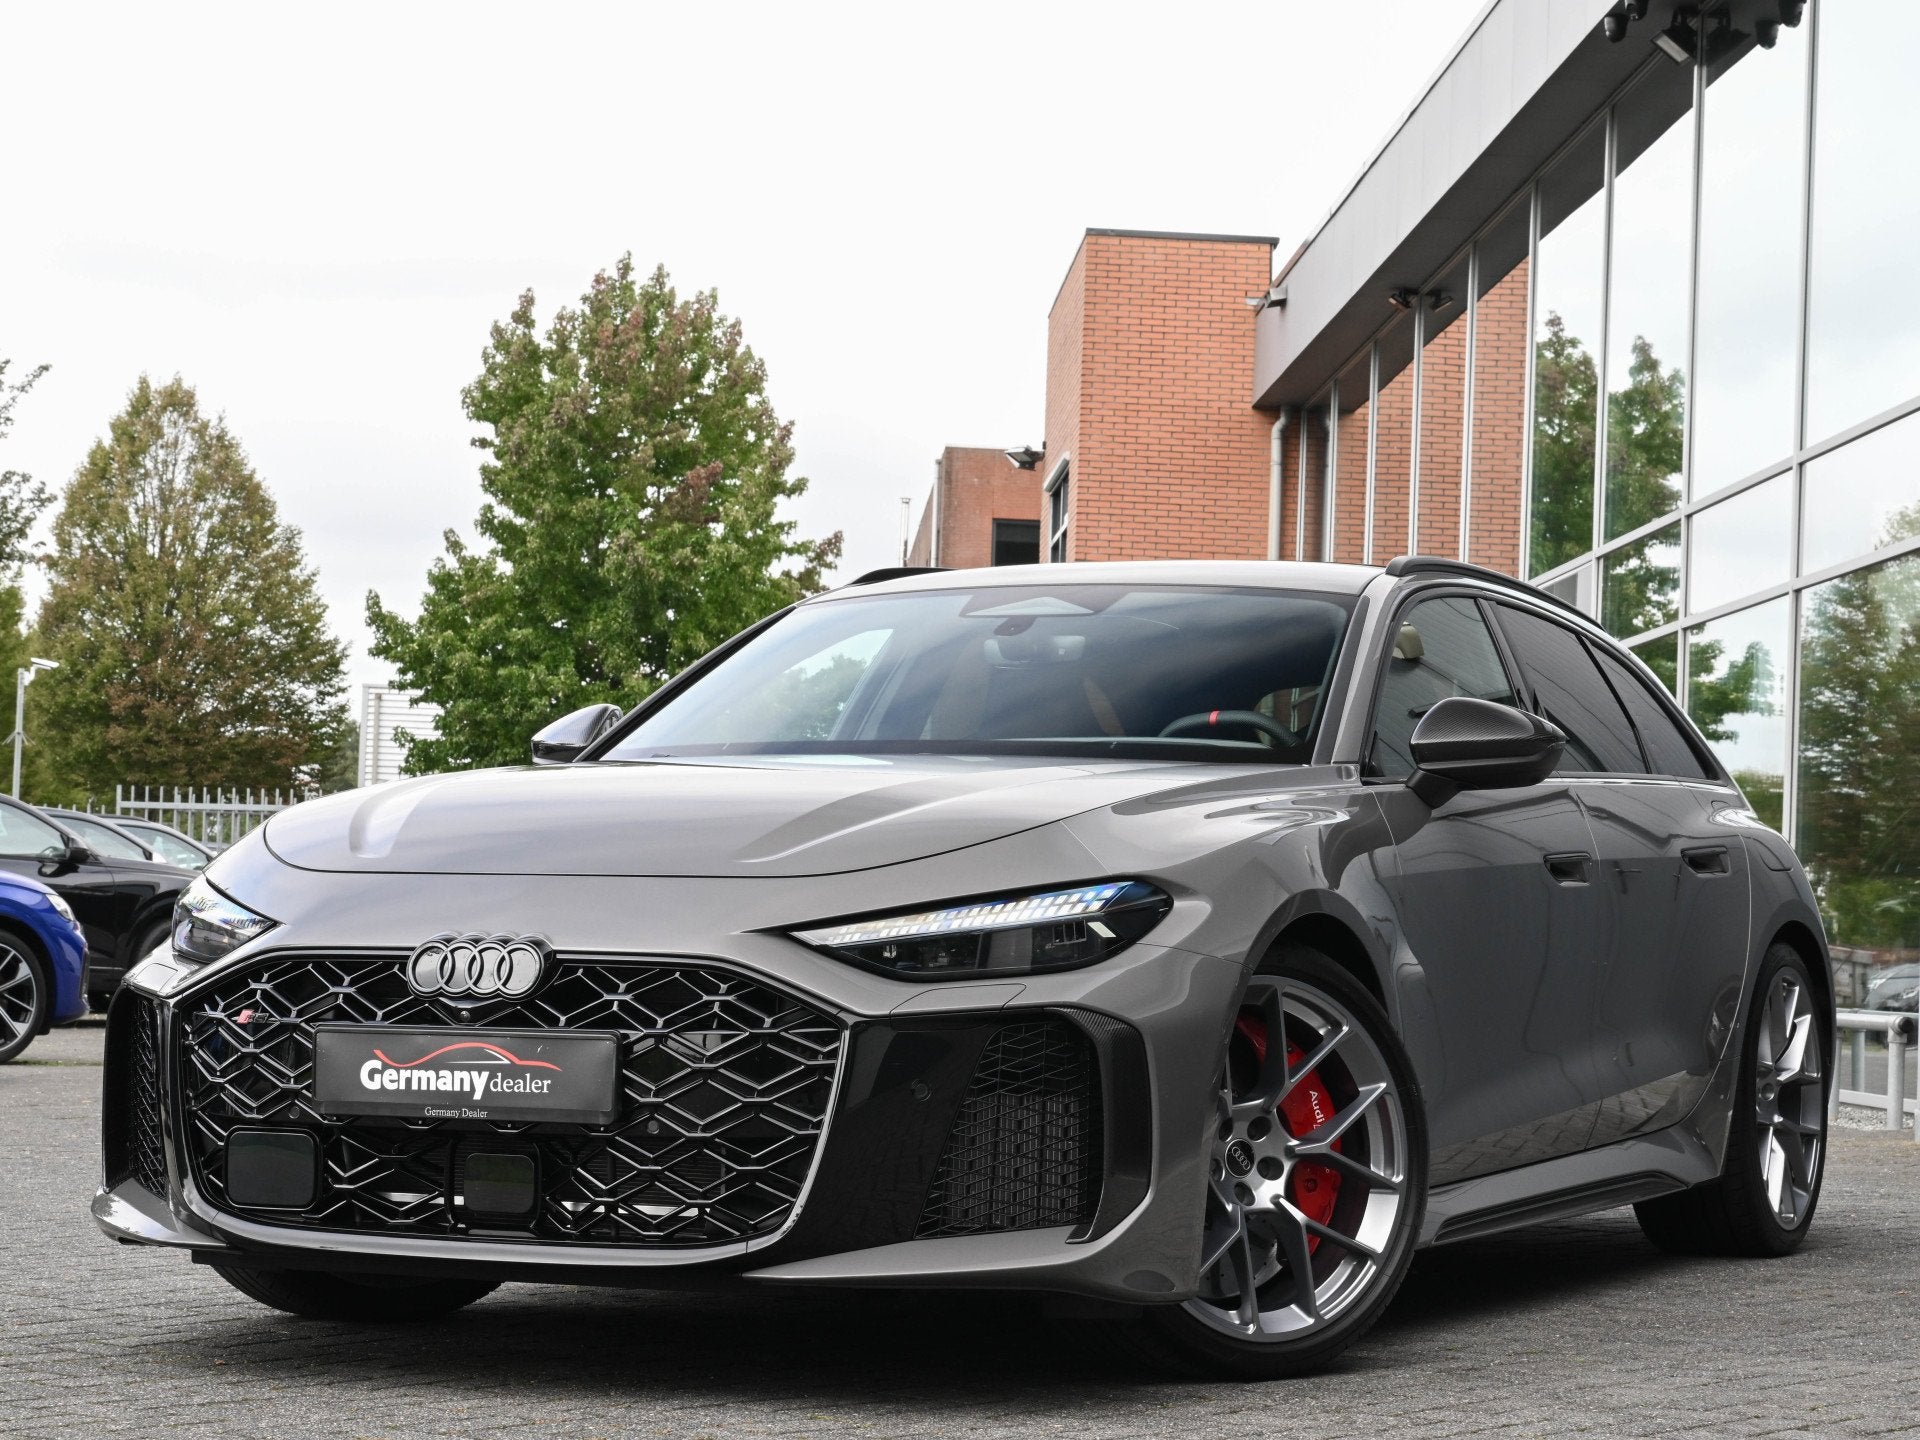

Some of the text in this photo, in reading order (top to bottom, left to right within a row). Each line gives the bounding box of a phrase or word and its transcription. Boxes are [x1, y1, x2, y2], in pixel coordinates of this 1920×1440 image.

[360, 1059, 551, 1100] Germany dealer
[424, 1106, 488, 1118] Germany Dealer
[1309, 1090, 1325, 1123] Audi
